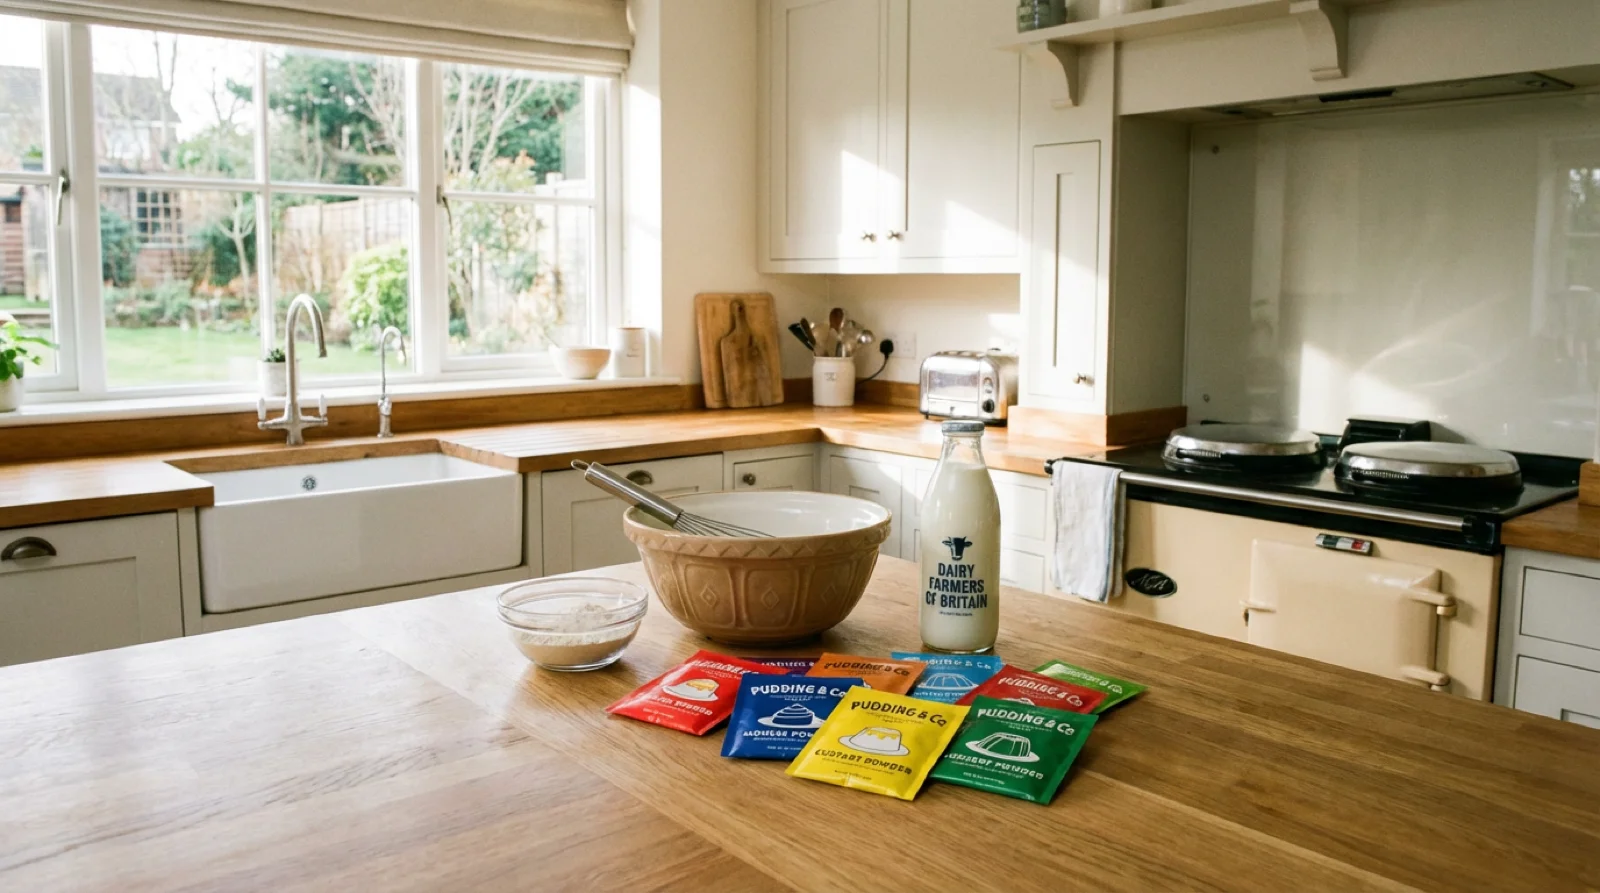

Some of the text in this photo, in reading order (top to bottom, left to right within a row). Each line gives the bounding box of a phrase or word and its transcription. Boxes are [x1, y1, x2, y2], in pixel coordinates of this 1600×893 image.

[938, 562, 975, 578] DAIRY
[929, 576, 985, 594] FARMERS
[940, 593, 988, 609] BRITAIN
[750, 684, 816, 696] PUDDING
[817, 685, 828, 695] &
[851, 700, 917, 717] PUDDING
[917, 711, 928, 720] &
[977, 708, 1045, 725] PUDDING
